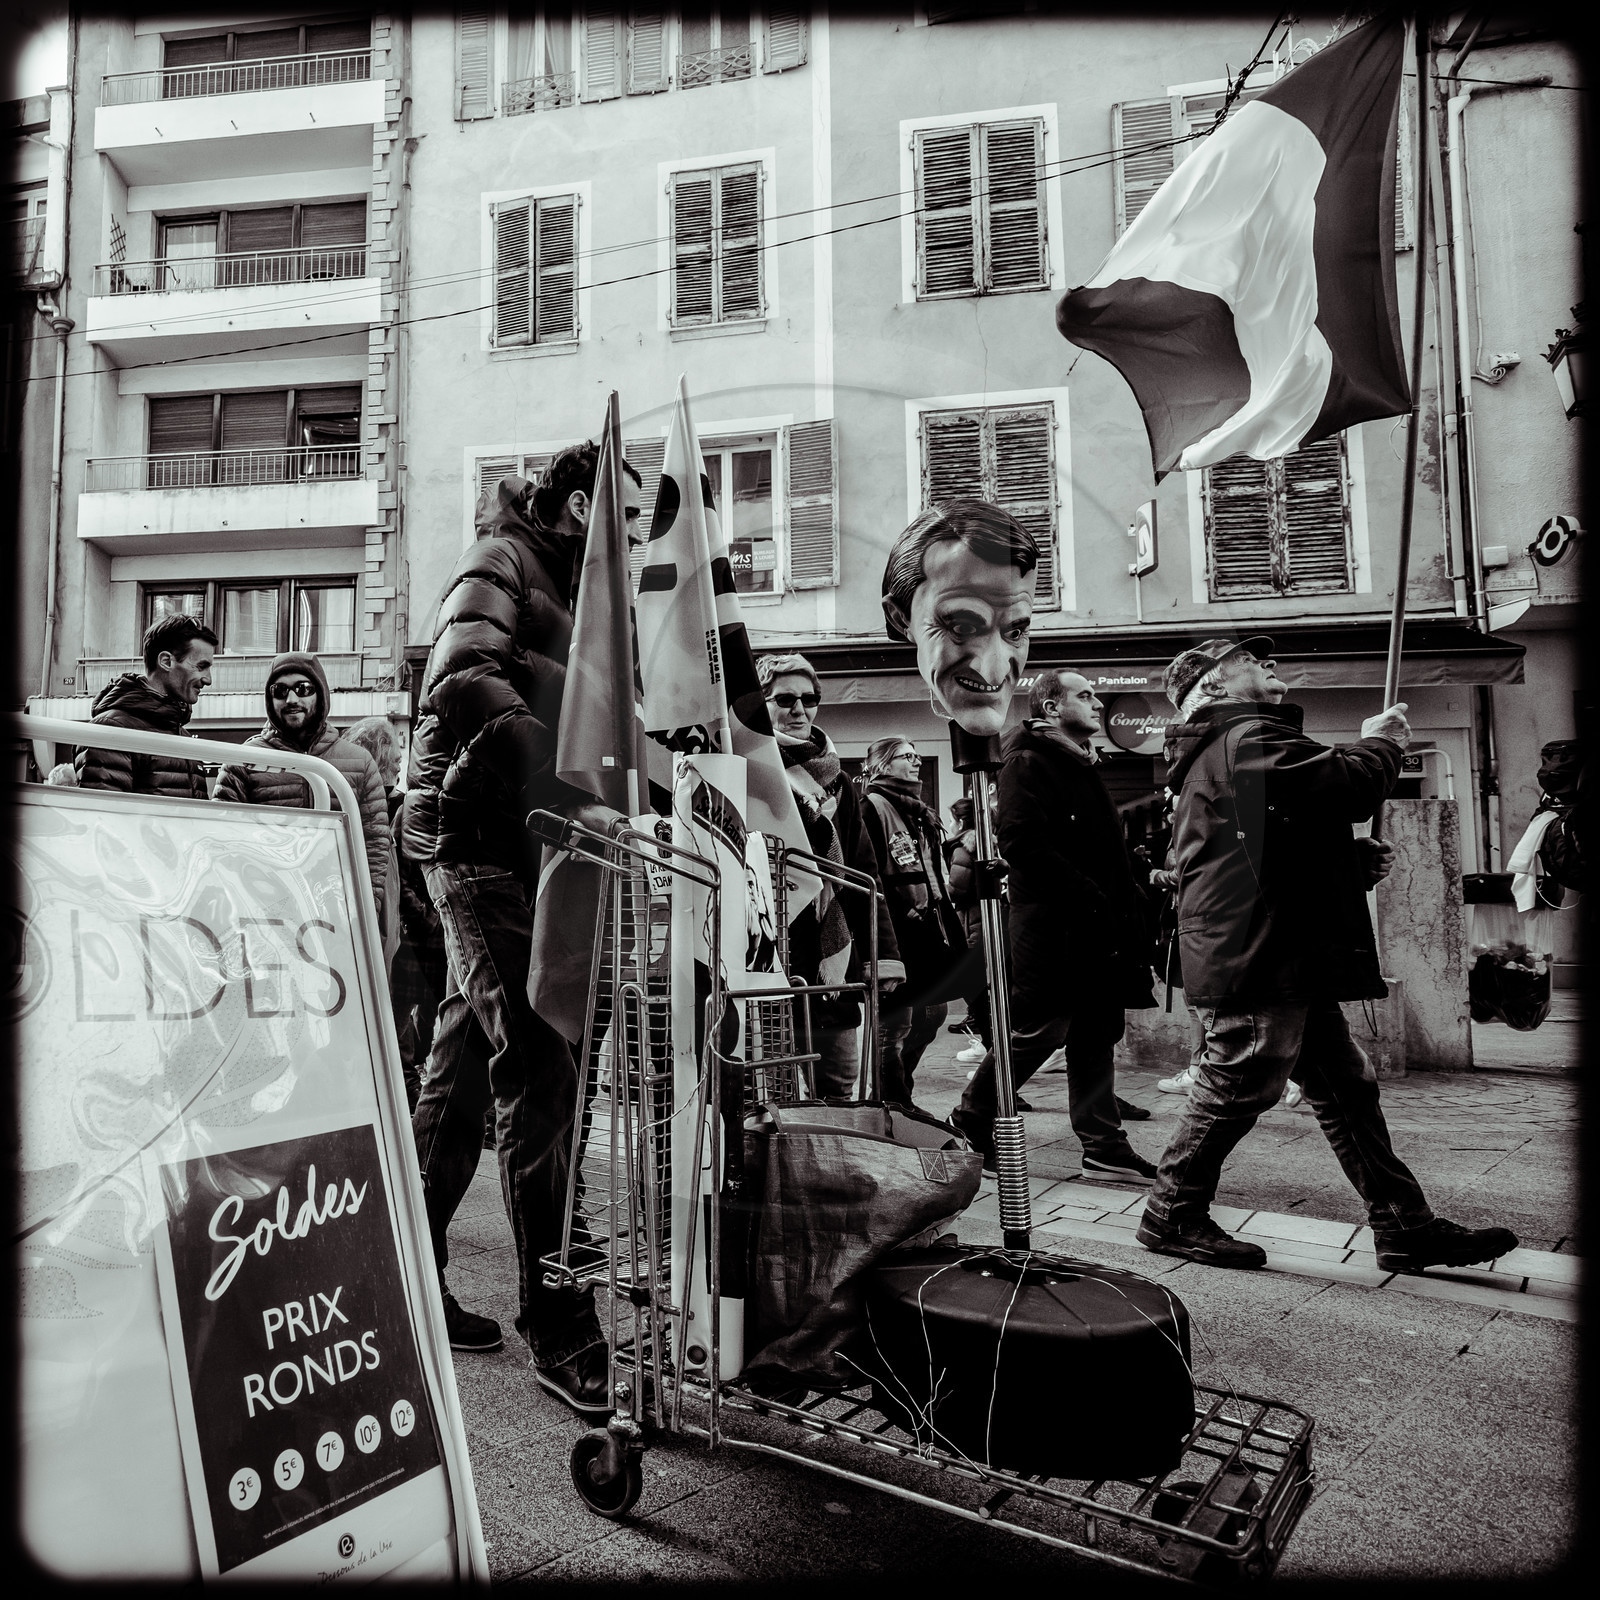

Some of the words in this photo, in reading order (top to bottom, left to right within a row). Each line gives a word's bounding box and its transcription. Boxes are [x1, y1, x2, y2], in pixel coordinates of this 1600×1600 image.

[1098, 675, 1147, 685] Pantalon
[1110, 712, 1179, 730] Comptoi
[1405, 757, 1419, 765] 30
[205, 1164, 369, 1301] Soldes
[262, 1286, 349, 1350] PRIX
[237, 1475, 254, 1501] 3€
[281, 1457, 299, 1482] 5€
[322, 1438, 338, 1463] 7€
[359, 1421, 378, 1446] 10€
[395, 1405, 413, 1429] 12€
[317, 1562, 354, 1584] Dessous
[378, 1538, 392, 1553] Vie
